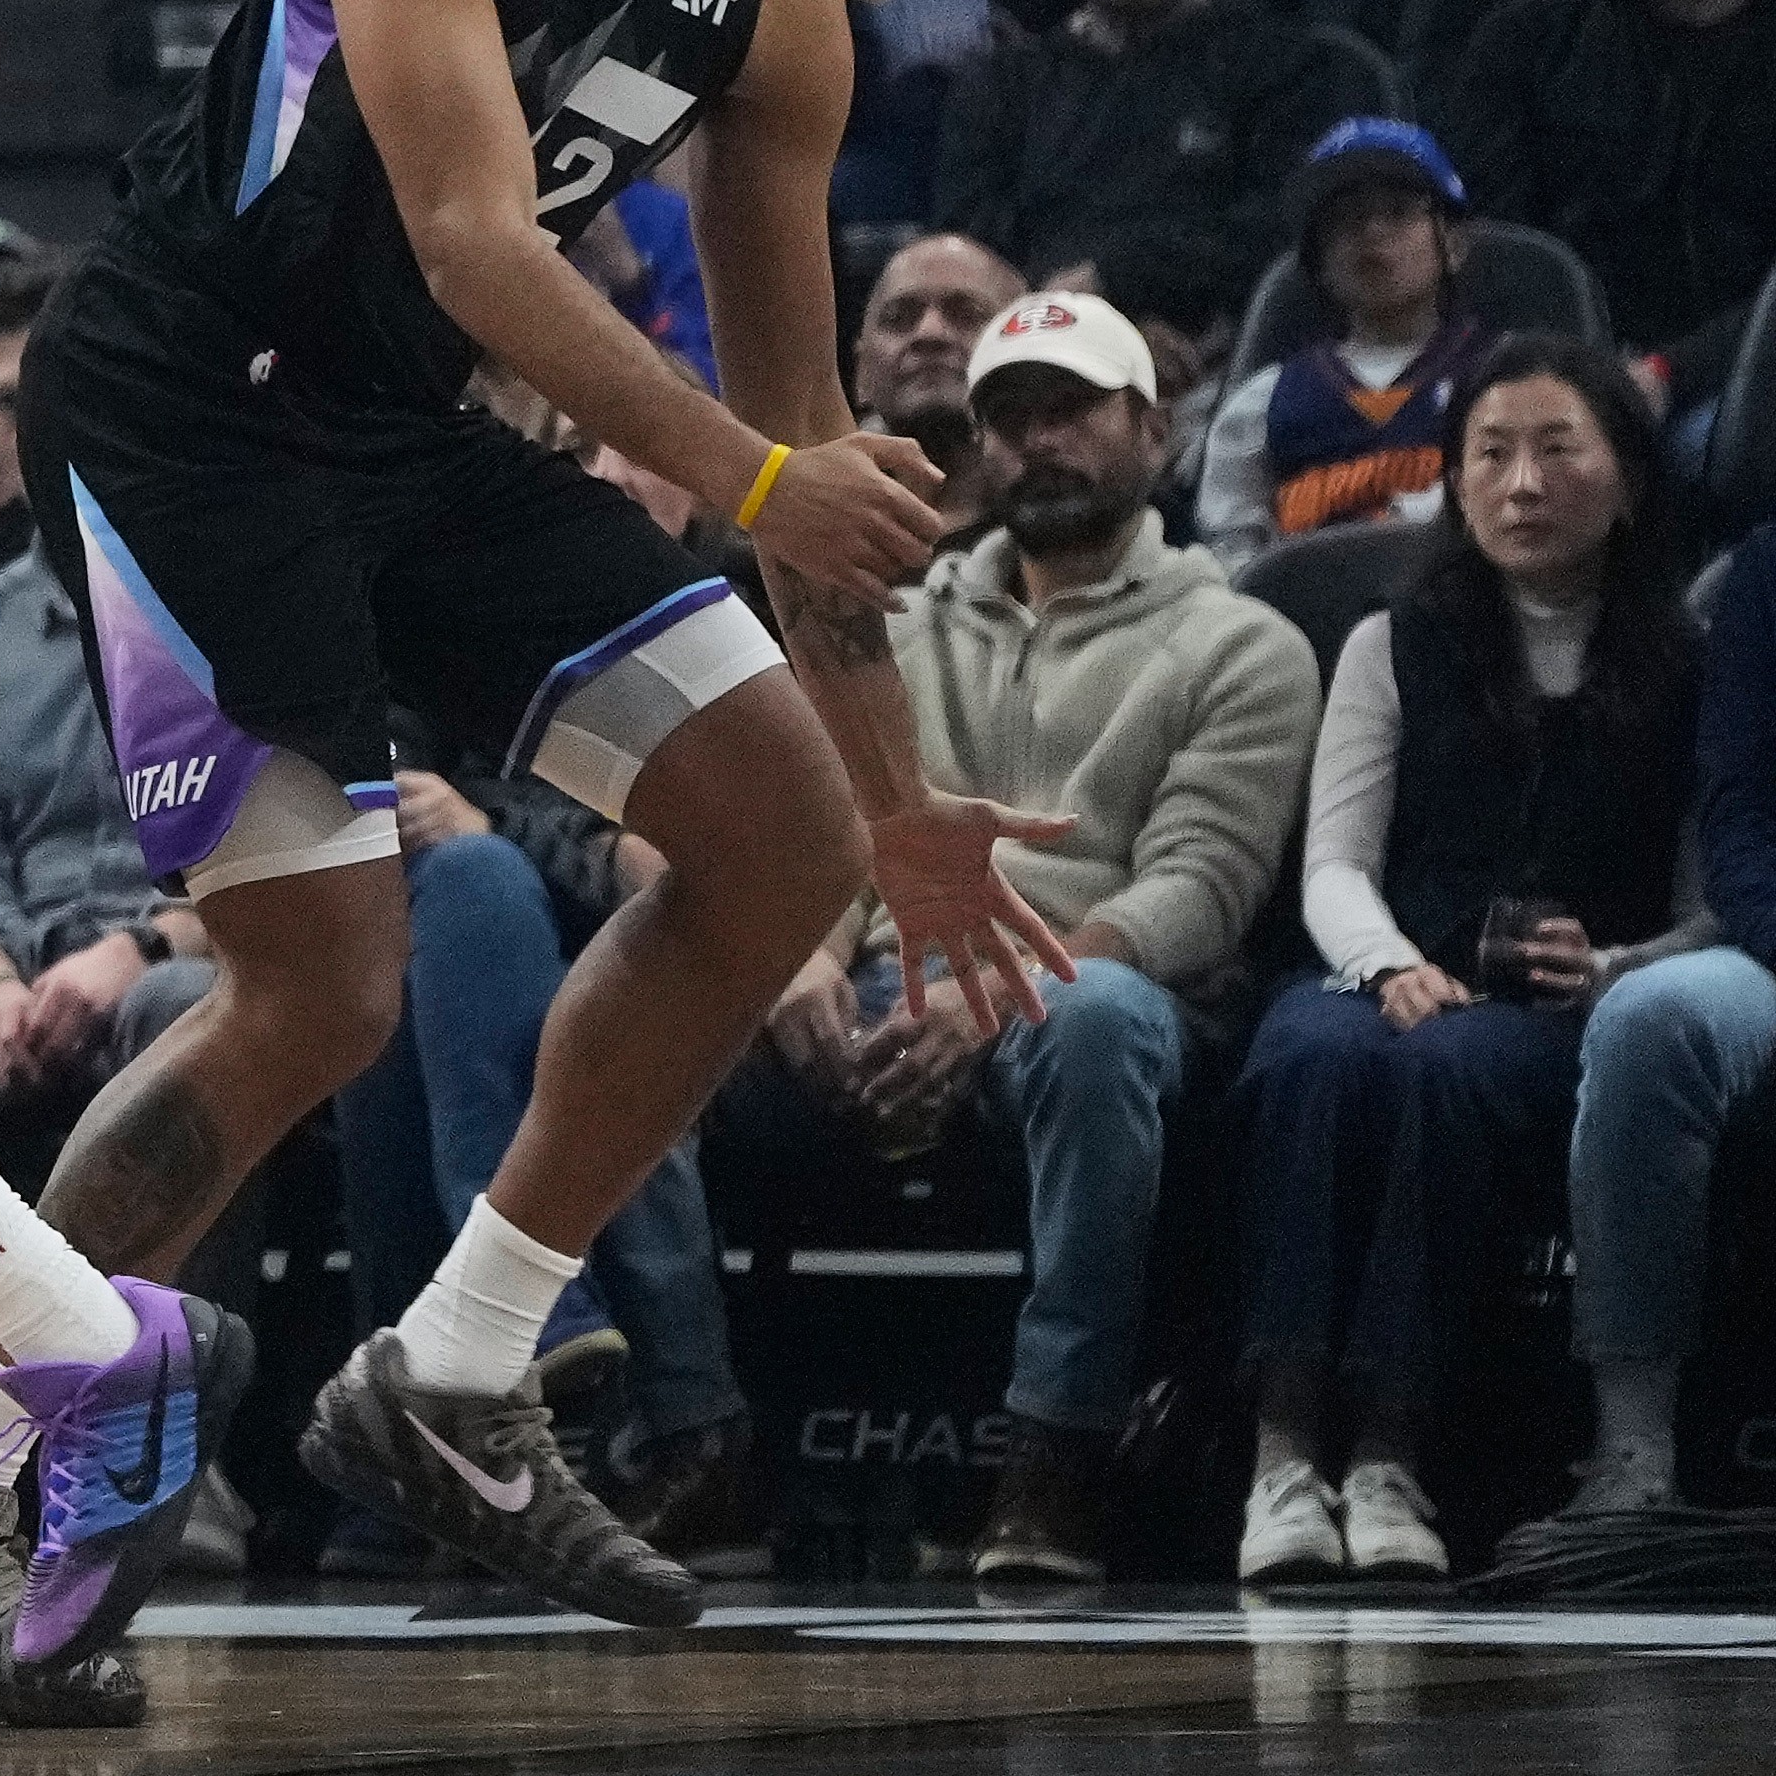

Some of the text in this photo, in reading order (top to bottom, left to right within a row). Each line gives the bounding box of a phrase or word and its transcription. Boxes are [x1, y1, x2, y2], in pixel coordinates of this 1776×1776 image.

[534, 136, 614, 250] 2
[126, 755, 217, 822] UTAH
[800, 1407, 1015, 1465] CHAS
